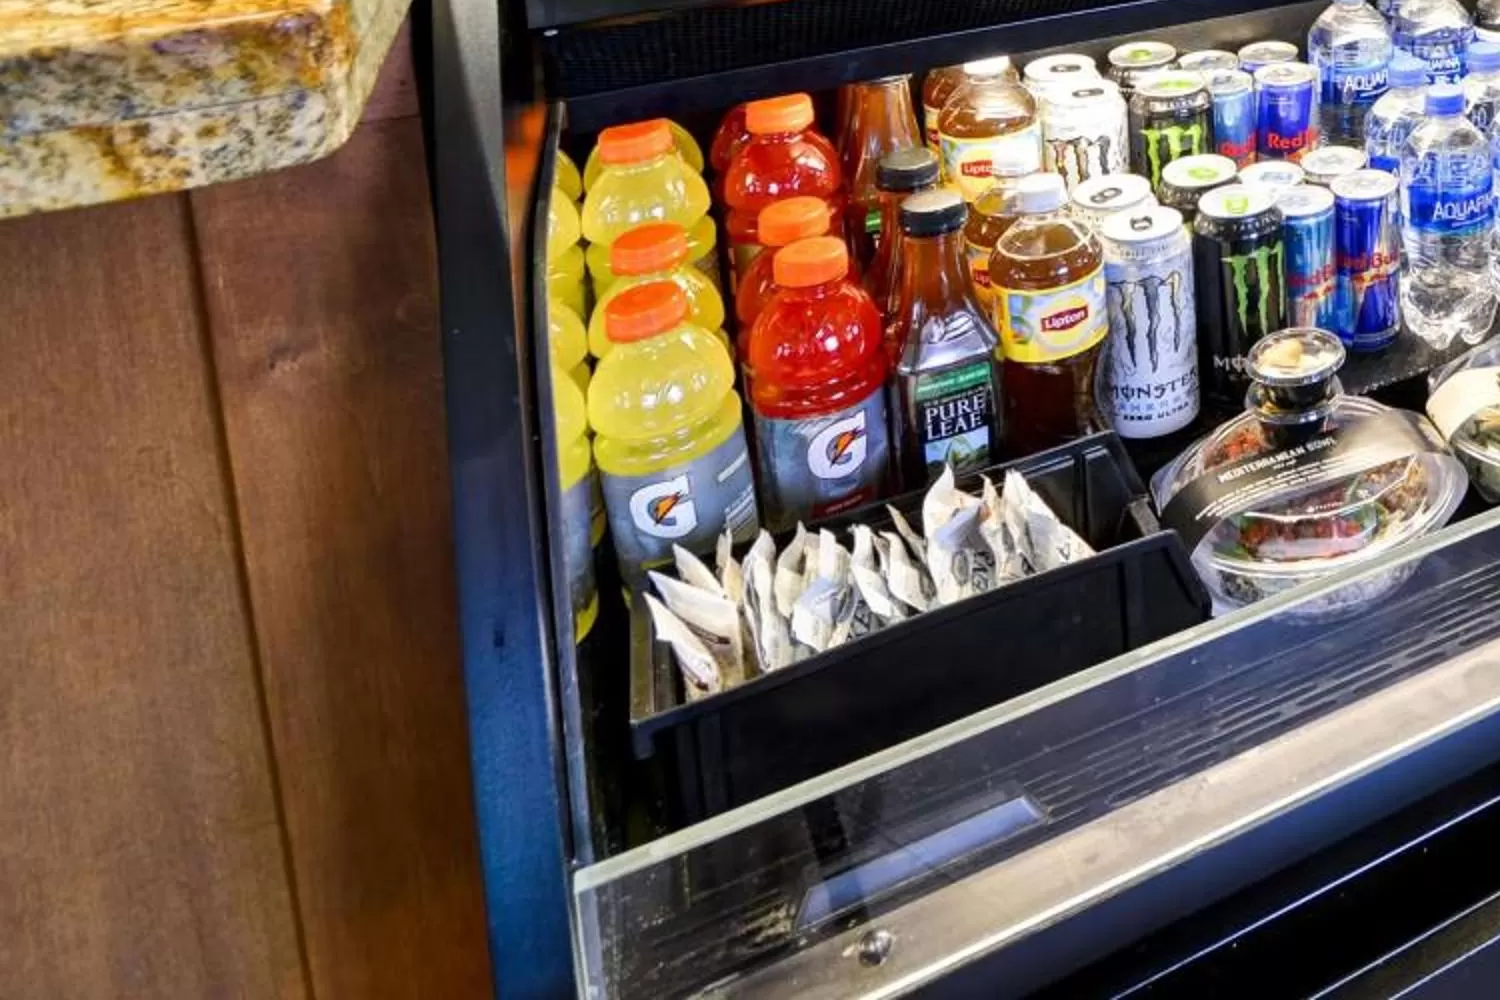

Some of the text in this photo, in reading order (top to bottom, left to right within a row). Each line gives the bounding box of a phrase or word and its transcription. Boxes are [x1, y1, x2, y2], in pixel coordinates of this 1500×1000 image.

[1267, 132, 1302, 149] Red
[1044, 310, 1085, 329] Lipton
[925, 391, 986, 423] PURE
[926, 413, 983, 441] LEAF
